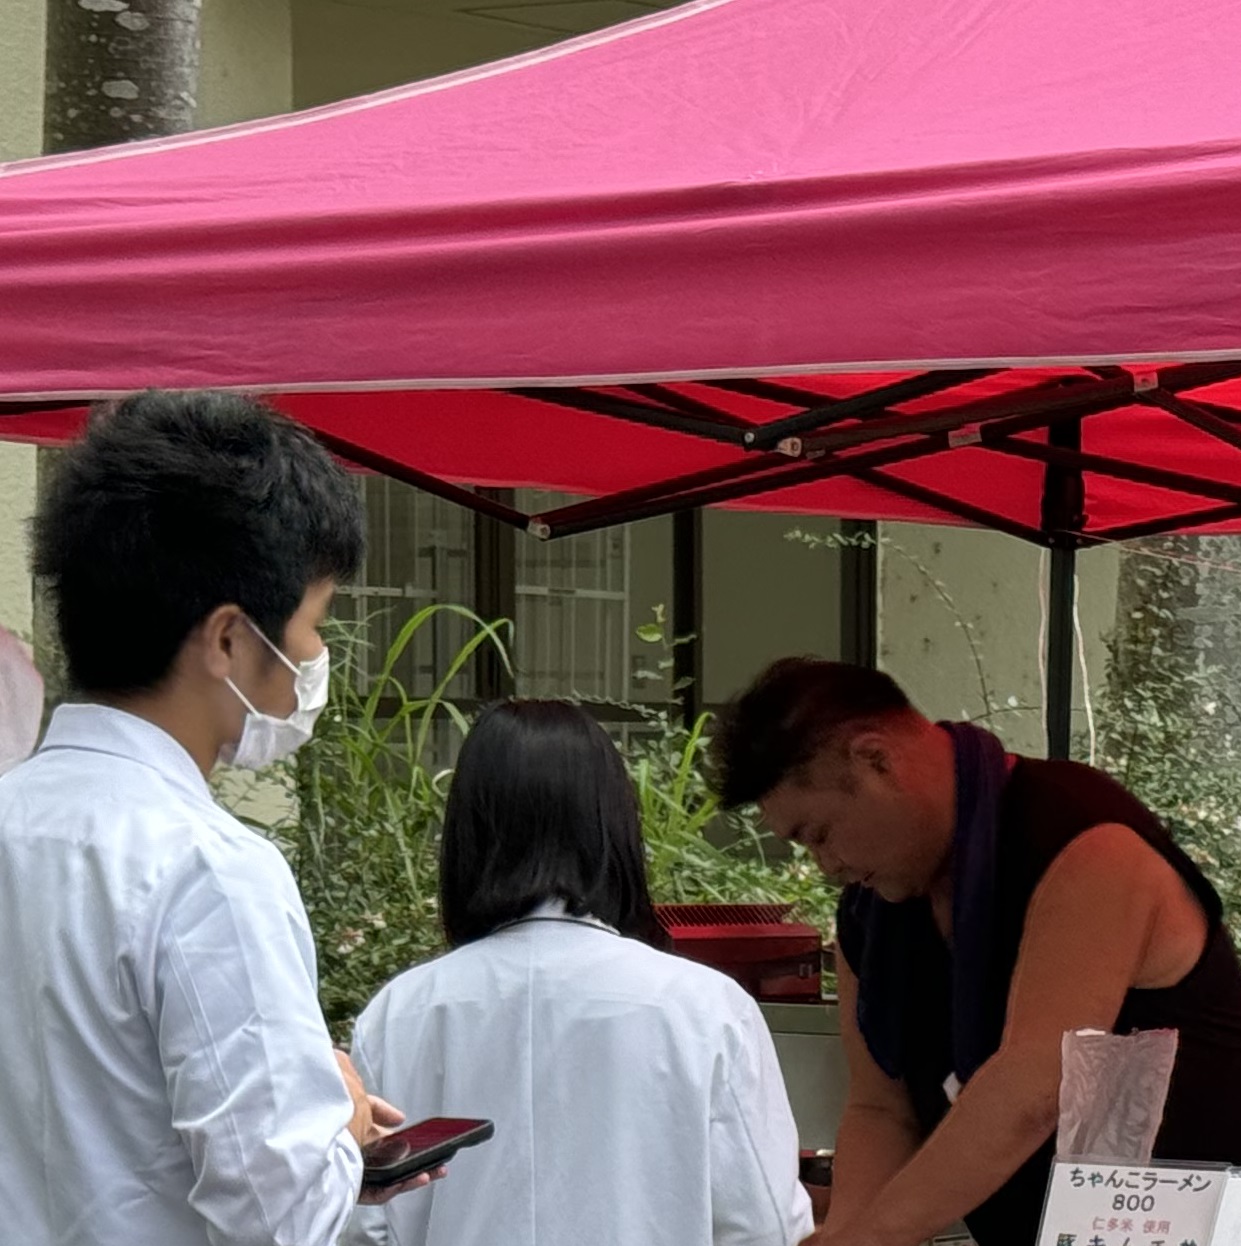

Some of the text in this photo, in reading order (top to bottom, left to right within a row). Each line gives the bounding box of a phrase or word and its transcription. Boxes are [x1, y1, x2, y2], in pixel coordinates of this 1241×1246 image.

[1070, 1167, 1211, 1192] ちゃんこラーメン
[1112, 1194, 1155, 1212] 800
[1143, 1218, 1171, 1235] 使用
